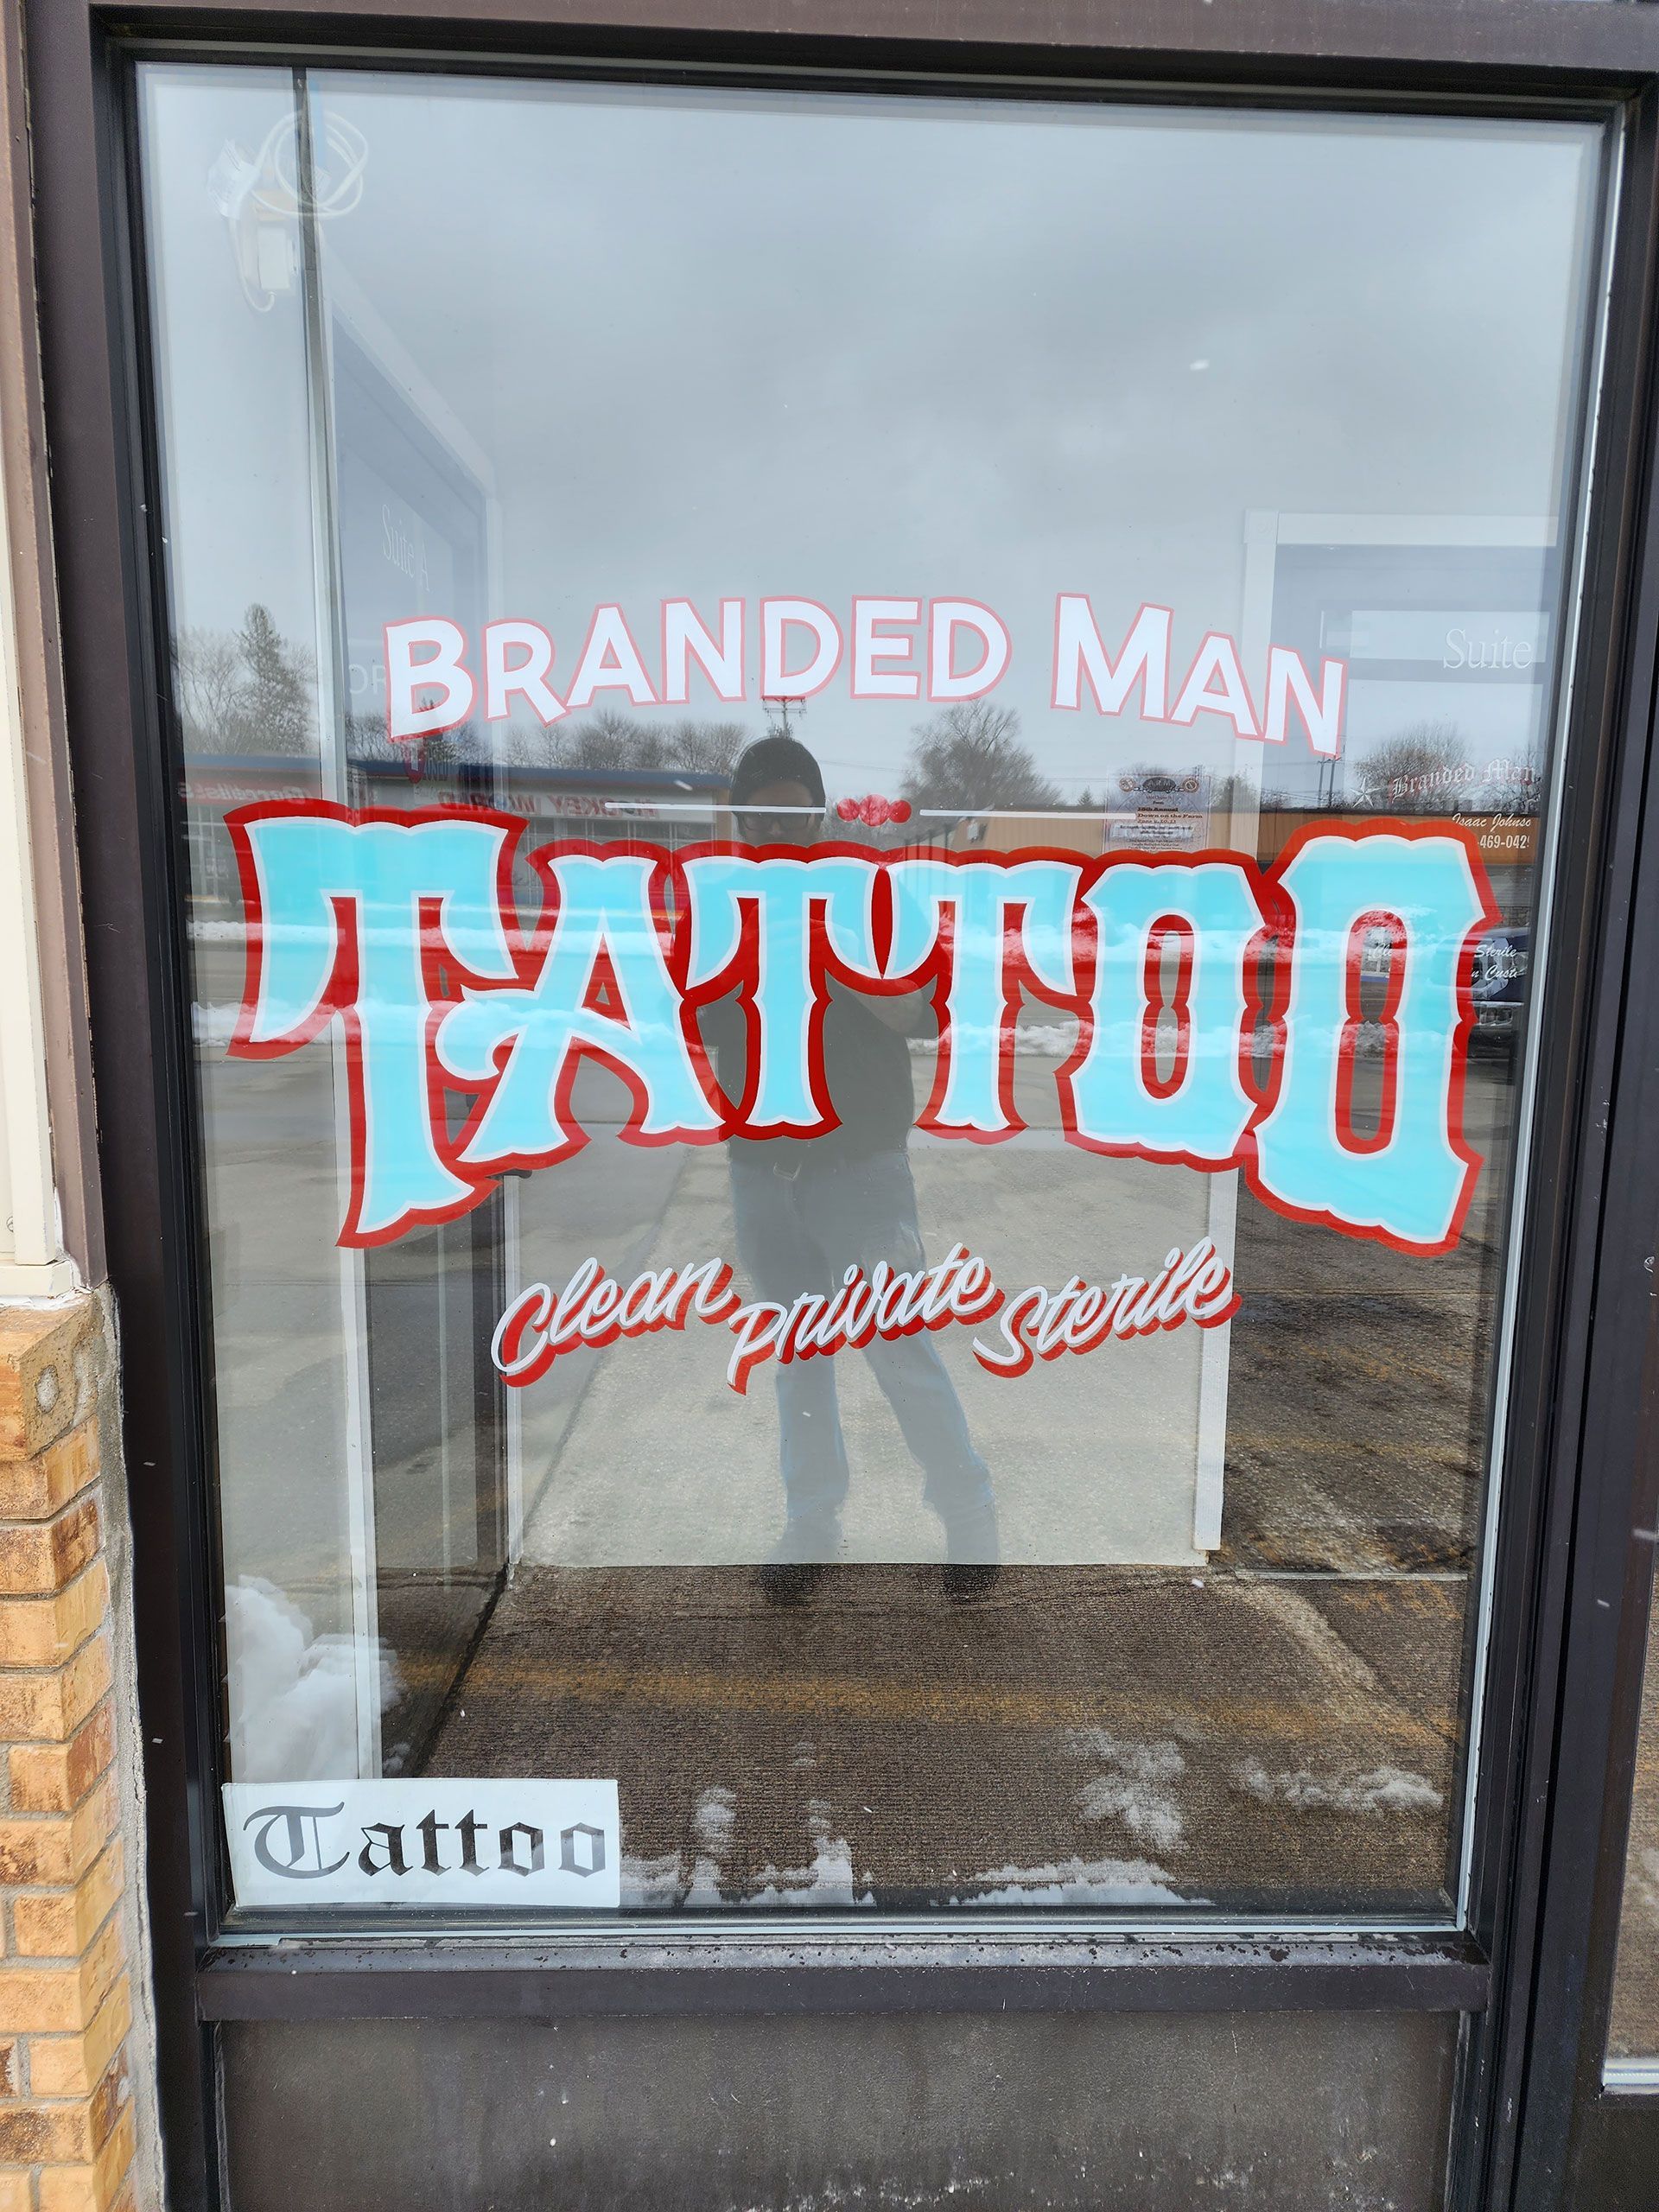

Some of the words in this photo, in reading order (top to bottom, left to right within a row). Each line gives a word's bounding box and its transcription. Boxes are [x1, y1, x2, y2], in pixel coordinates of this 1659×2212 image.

[383, 595, 1014, 742] BRANDED
[1051, 592, 1348, 760] MAN
[1442, 627, 1534, 670] Suite
[1473, 944, 1517, 958] Sterile
[224, 798, 1505, 1257] TATTOO
[491, 1256, 739, 1388] Clean
[972, 1235, 1242, 1379] Sterile
[243, 1801, 607, 1879] Tattoo
